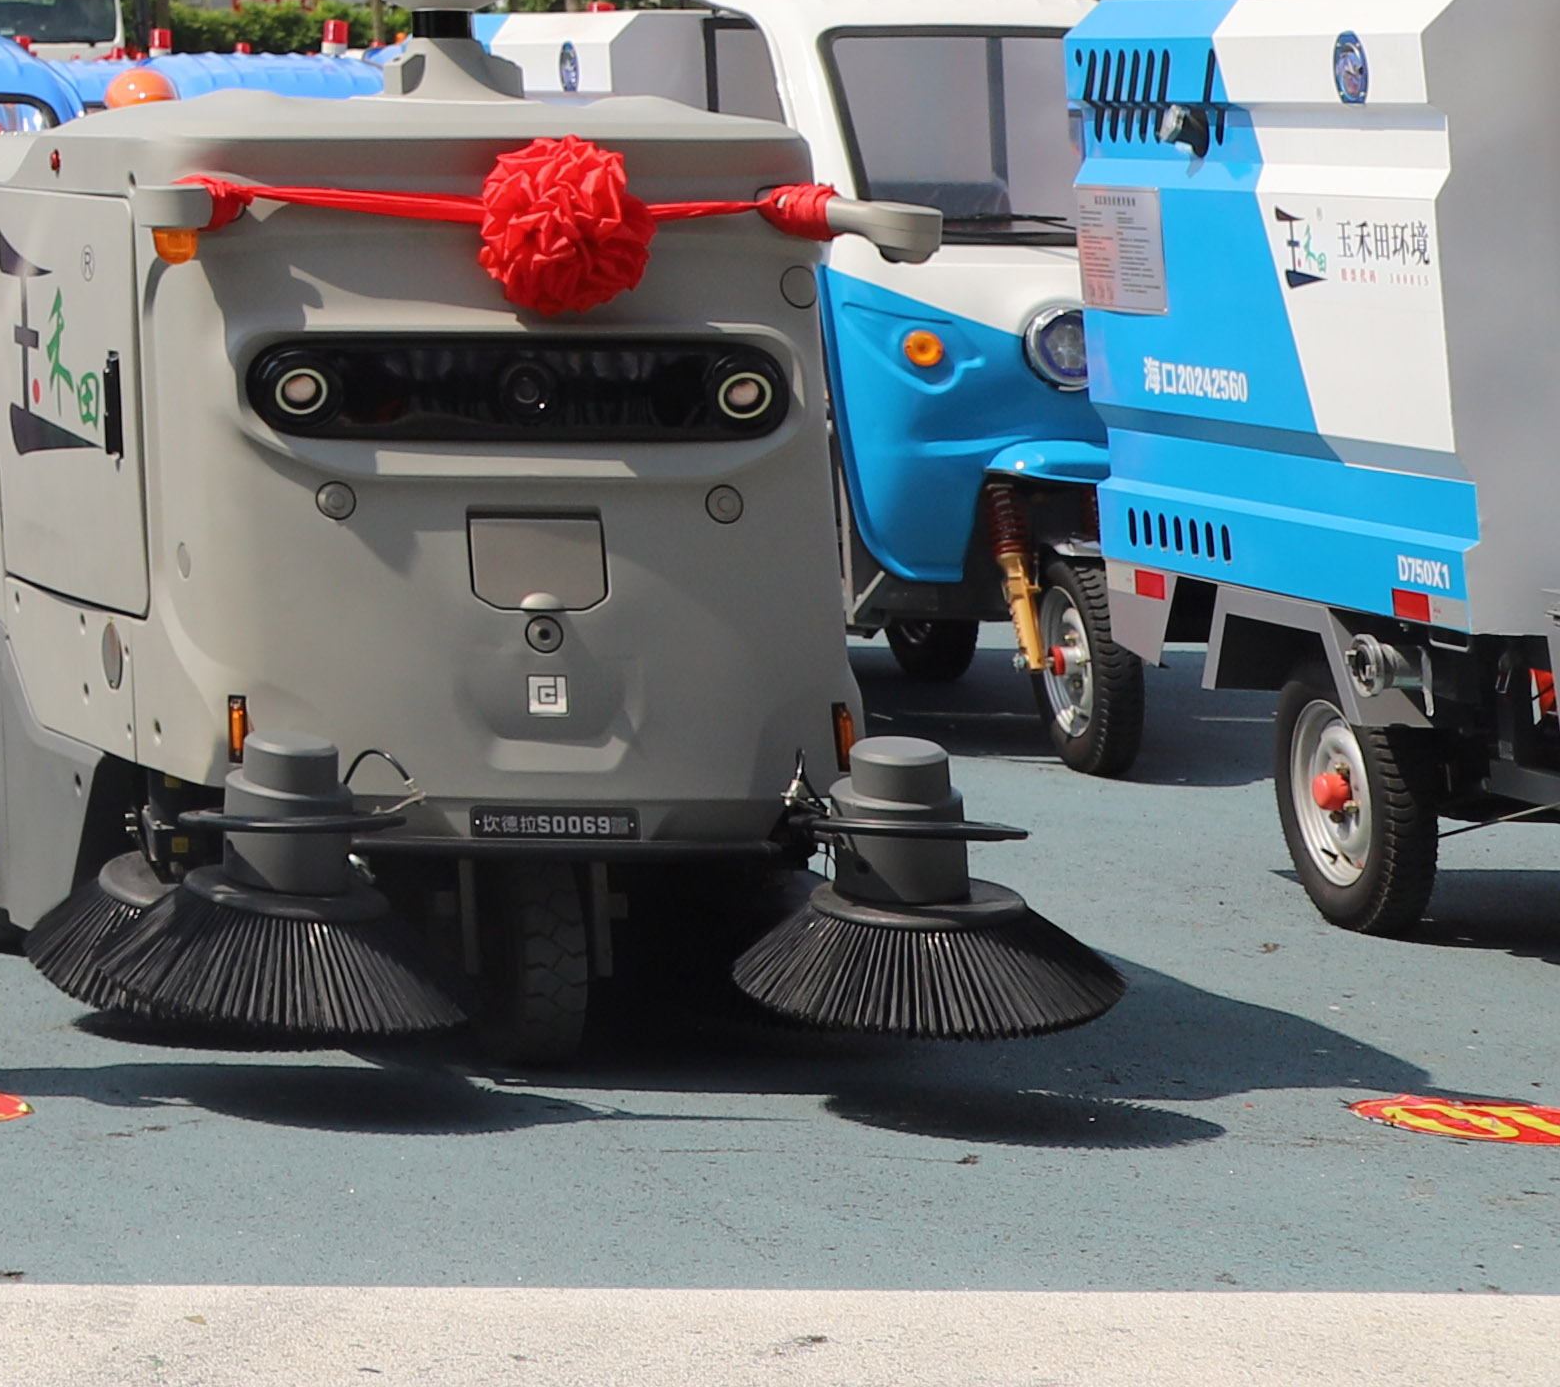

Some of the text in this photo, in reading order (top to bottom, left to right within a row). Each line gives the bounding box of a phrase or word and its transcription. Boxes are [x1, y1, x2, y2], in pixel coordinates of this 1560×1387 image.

[1336, 220, 1430, 266] 玉禾田环境
[1143, 356, 1249, 404] 海口20242560
[1396, 554, 1451, 590] D750X1
[482, 815, 611, 834] 坎德拉S0069
